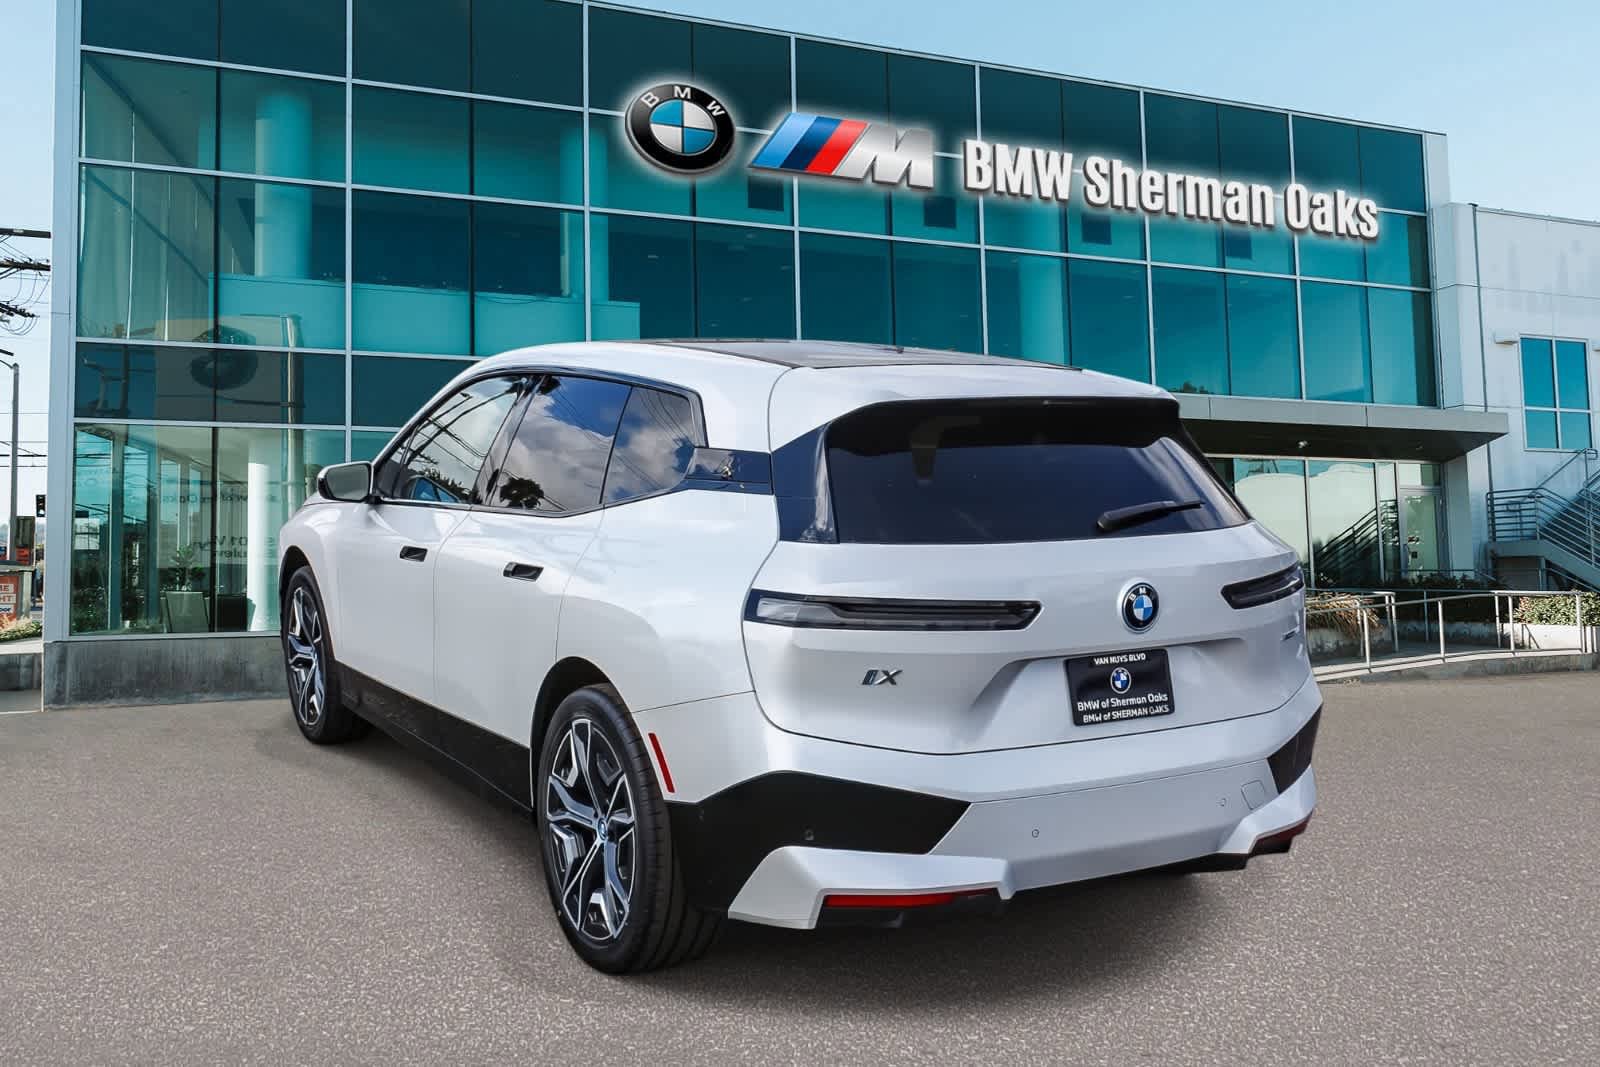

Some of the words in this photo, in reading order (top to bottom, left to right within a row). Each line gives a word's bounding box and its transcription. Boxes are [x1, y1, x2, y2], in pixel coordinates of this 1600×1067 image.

[641, 85, 725, 117] BMW
[832, 122, 935, 189] M
[963, 138, 1073, 202] BMW
[1082, 155, 1275, 227] Sherman
[1284, 182, 1379, 240] Oaks
[1093, 656, 1109, 665] VAN
[1110, 655, 1128, 664] NUYS
[1128, 652, 1146, 662] BLVD
[1077, 700, 1100, 712] BMW
[1101, 698, 1109, 709] of
[1110, 696, 1147, 708] Sherman
[1147, 692, 1168, 703] Oaks
[1083, 713, 1102, 723] BMW
[1103, 711, 1111, 721] of
[1111, 707, 1148, 720] SHERMAN
[1148, 704, 1169, 715] OAKS
